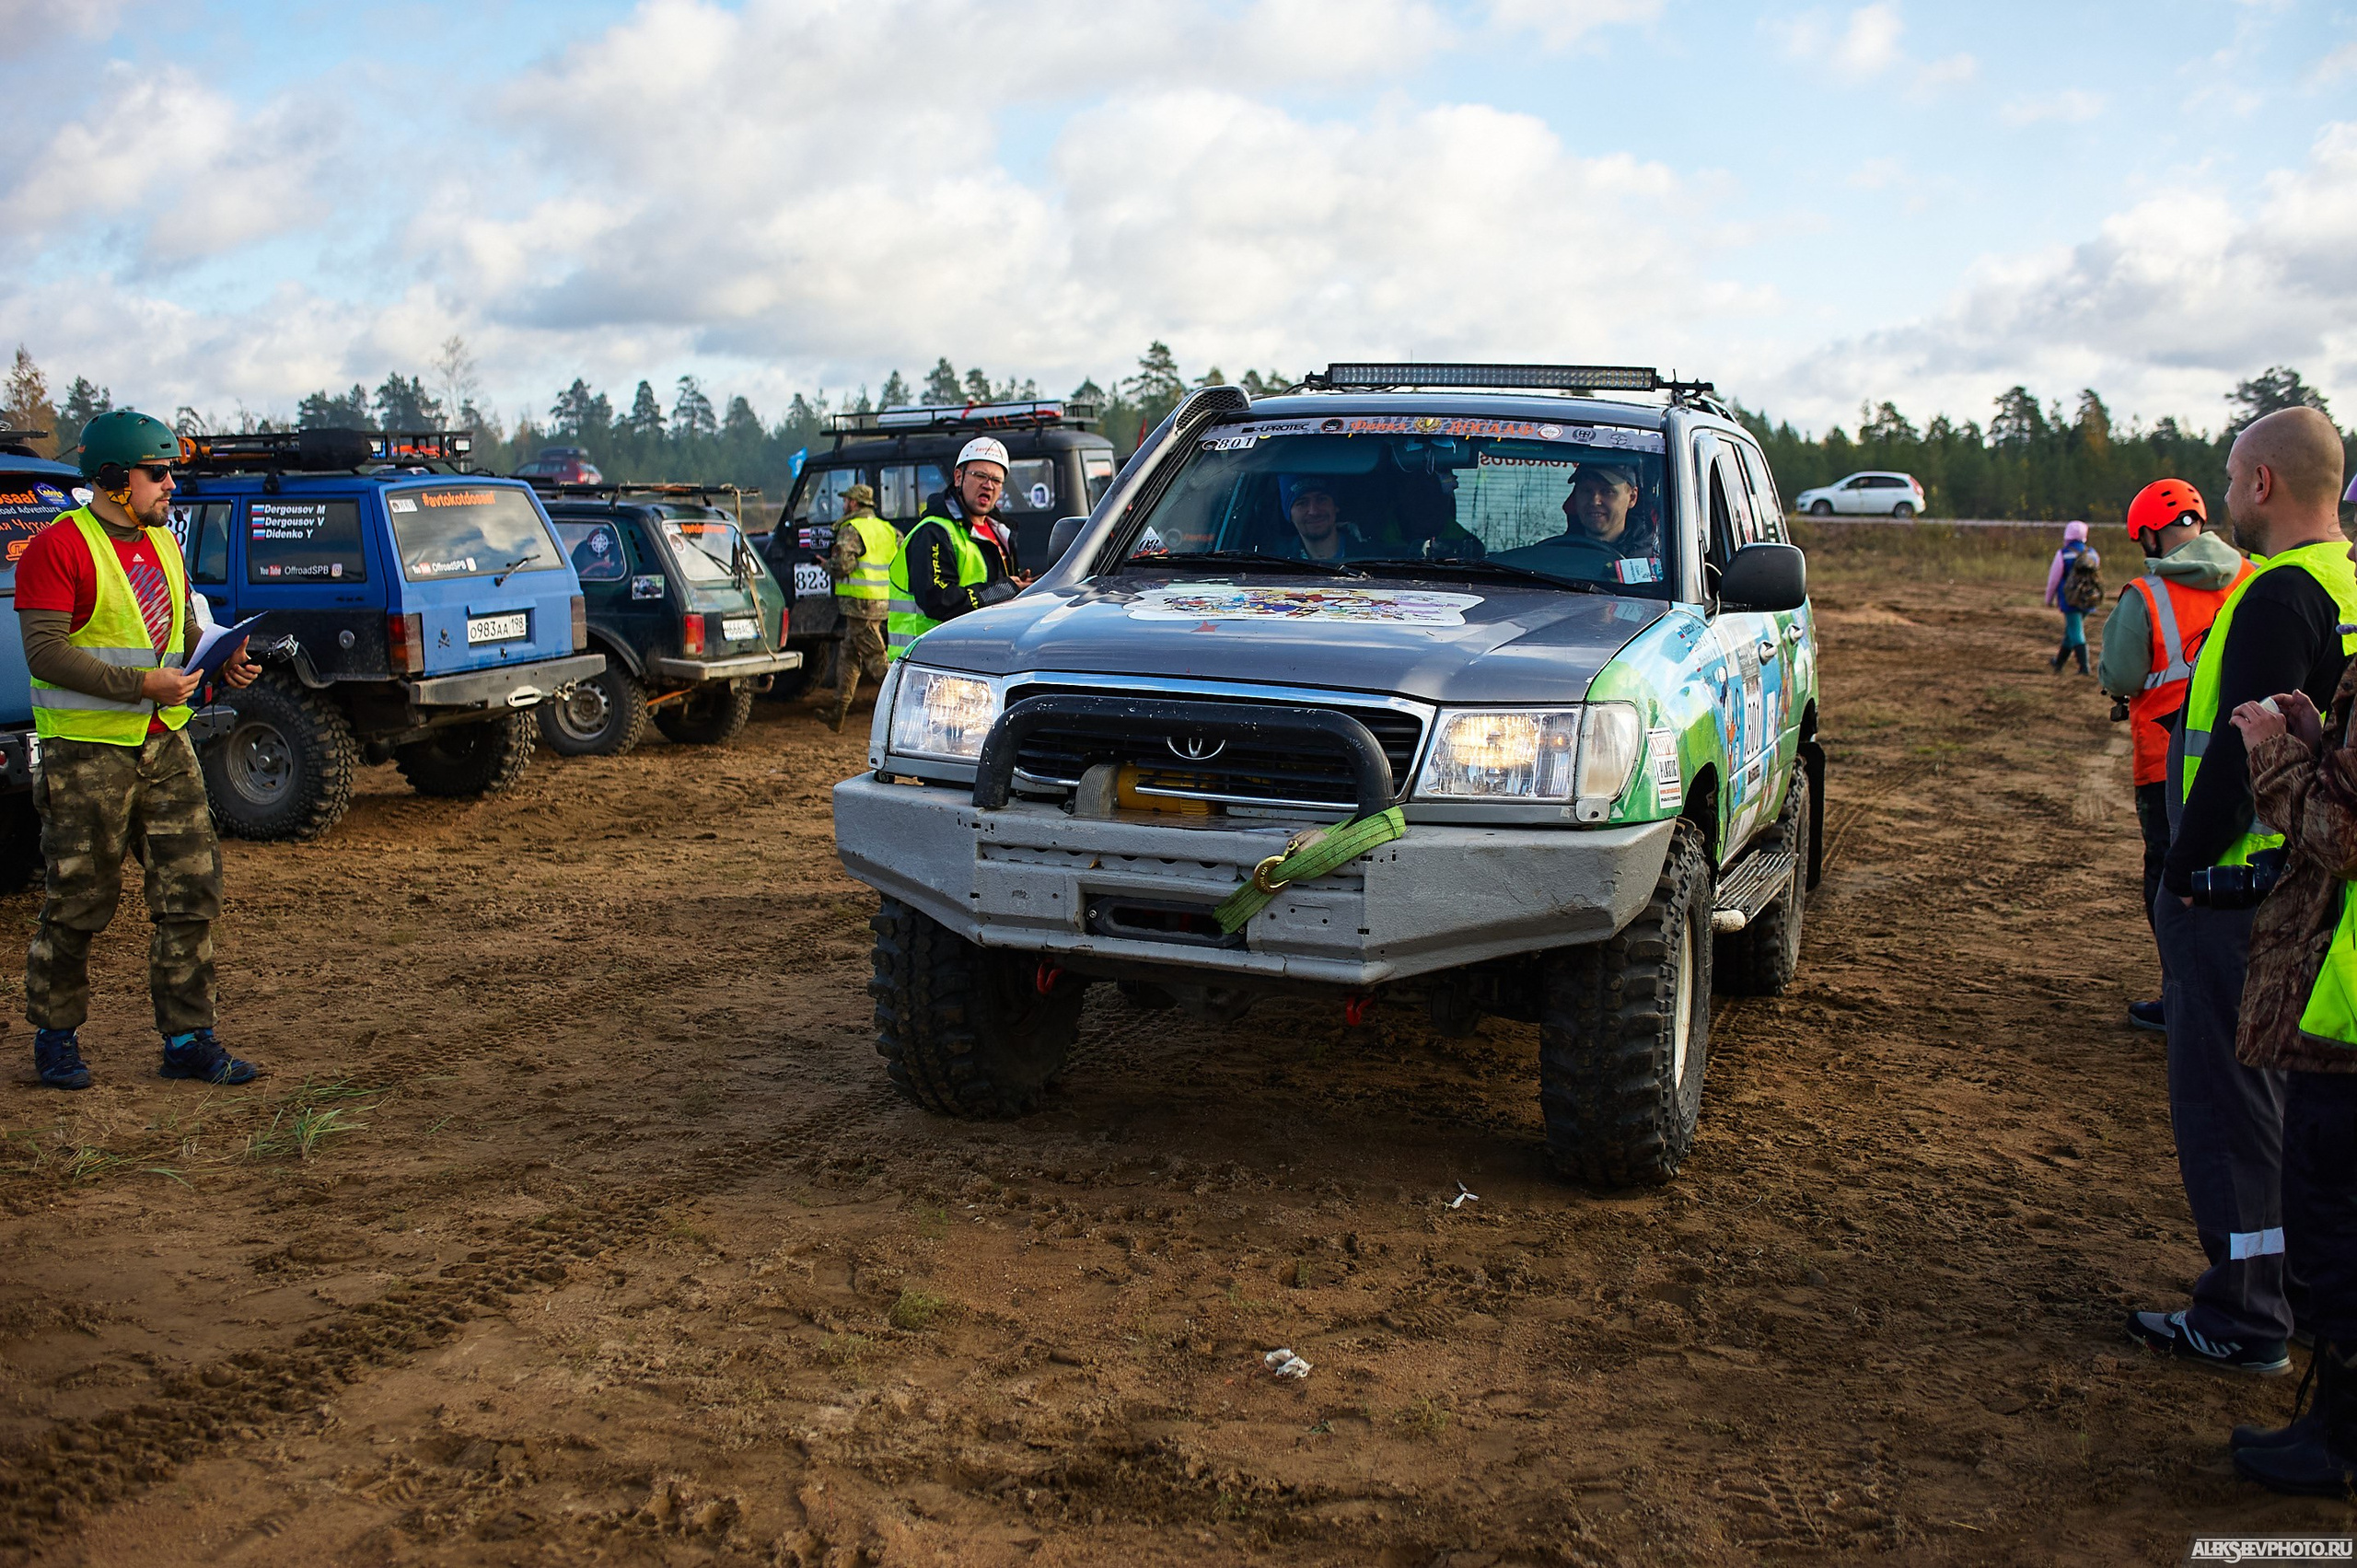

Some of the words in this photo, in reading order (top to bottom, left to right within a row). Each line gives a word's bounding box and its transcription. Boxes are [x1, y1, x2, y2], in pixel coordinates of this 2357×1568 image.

[1351, 420, 1406, 431] Финал
[1446, 421, 1535, 436] ДОСААФ
[1217, 437, 1253, 448] 801
[17, 505, 63, 514] Adventure
[264, 504, 314, 516] Dergousov
[316, 505, 326, 515] M
[265, 517, 315, 528] Dergousov
[318, 517, 325, 527] V
[266, 528, 304, 539] Didenko
[306, 528, 313, 539] Y
[284, 564, 329, 575] OffroadSPB
[795, 571, 829, 590] 823
[511, 617, 524, 633] 198
